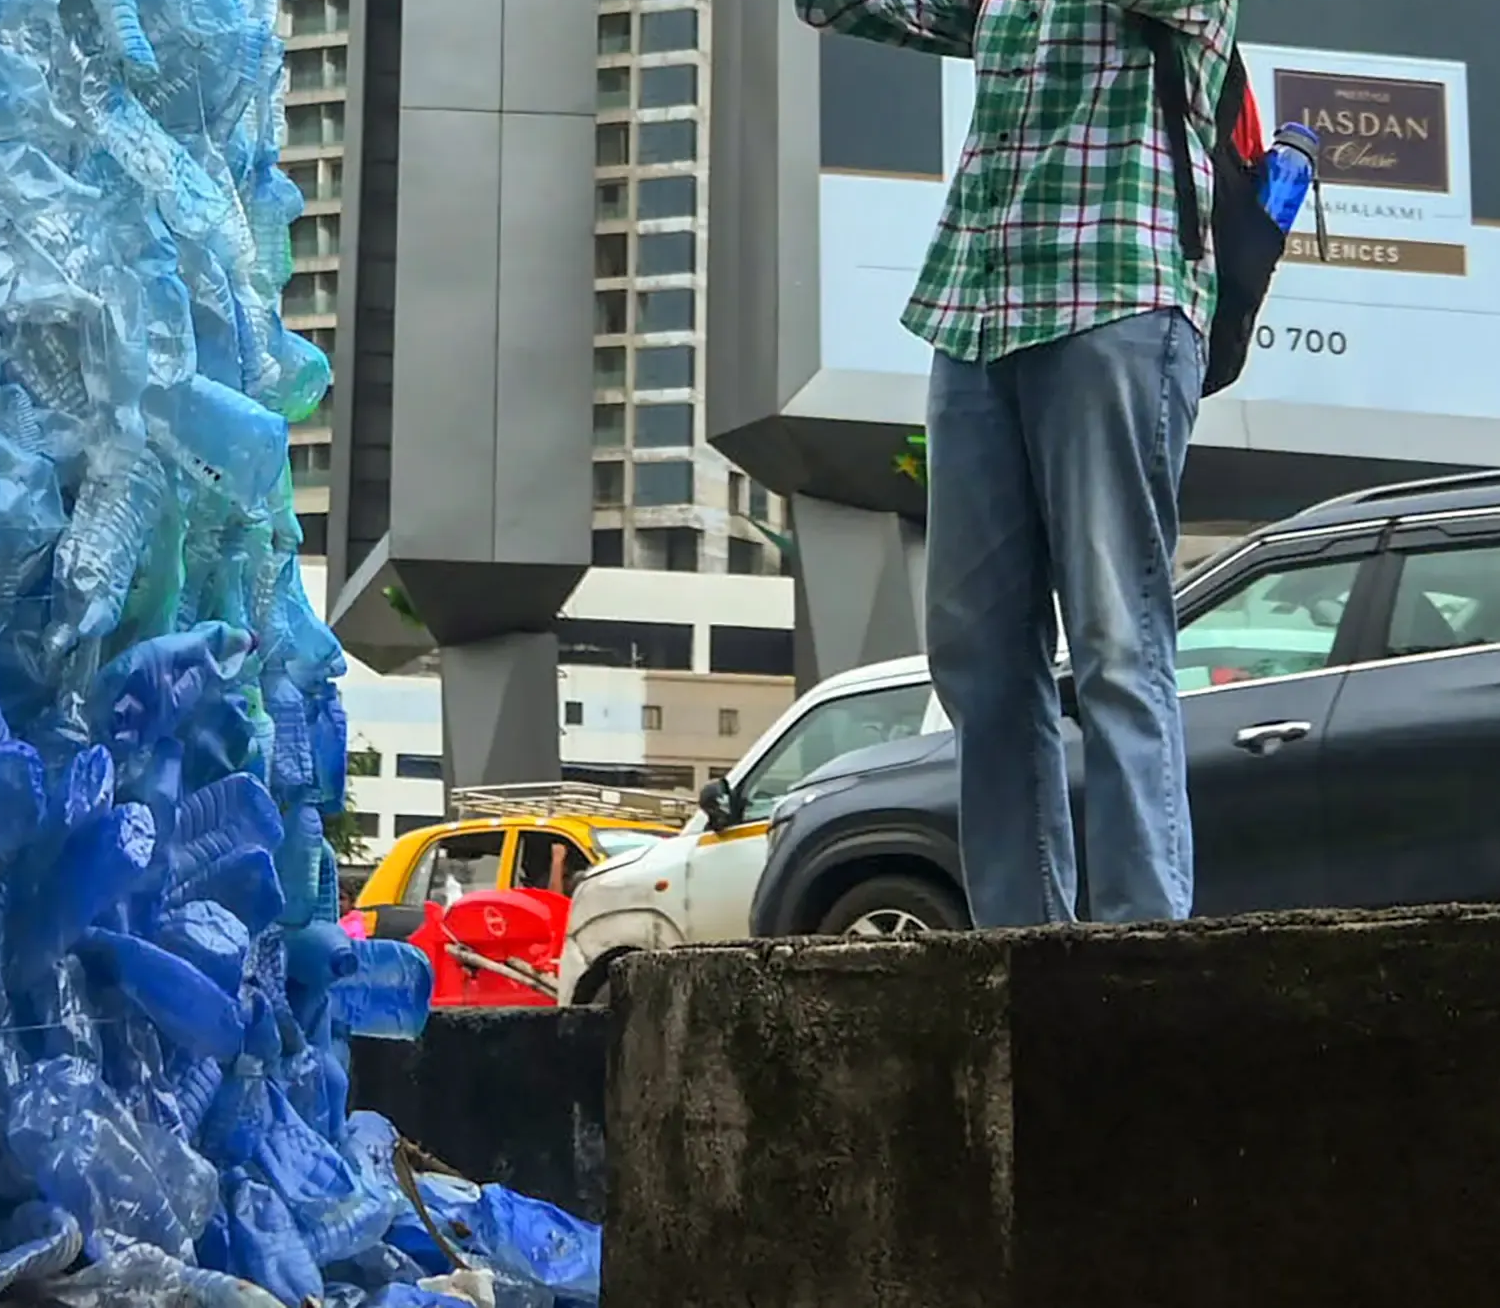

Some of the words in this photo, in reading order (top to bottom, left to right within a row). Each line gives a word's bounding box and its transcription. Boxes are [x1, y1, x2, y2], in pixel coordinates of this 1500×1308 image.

[1302, 107, 1429, 141] JASDAN
[1283, 238, 1400, 263] SIENCES
[1286, 327, 1348, 356] 700
